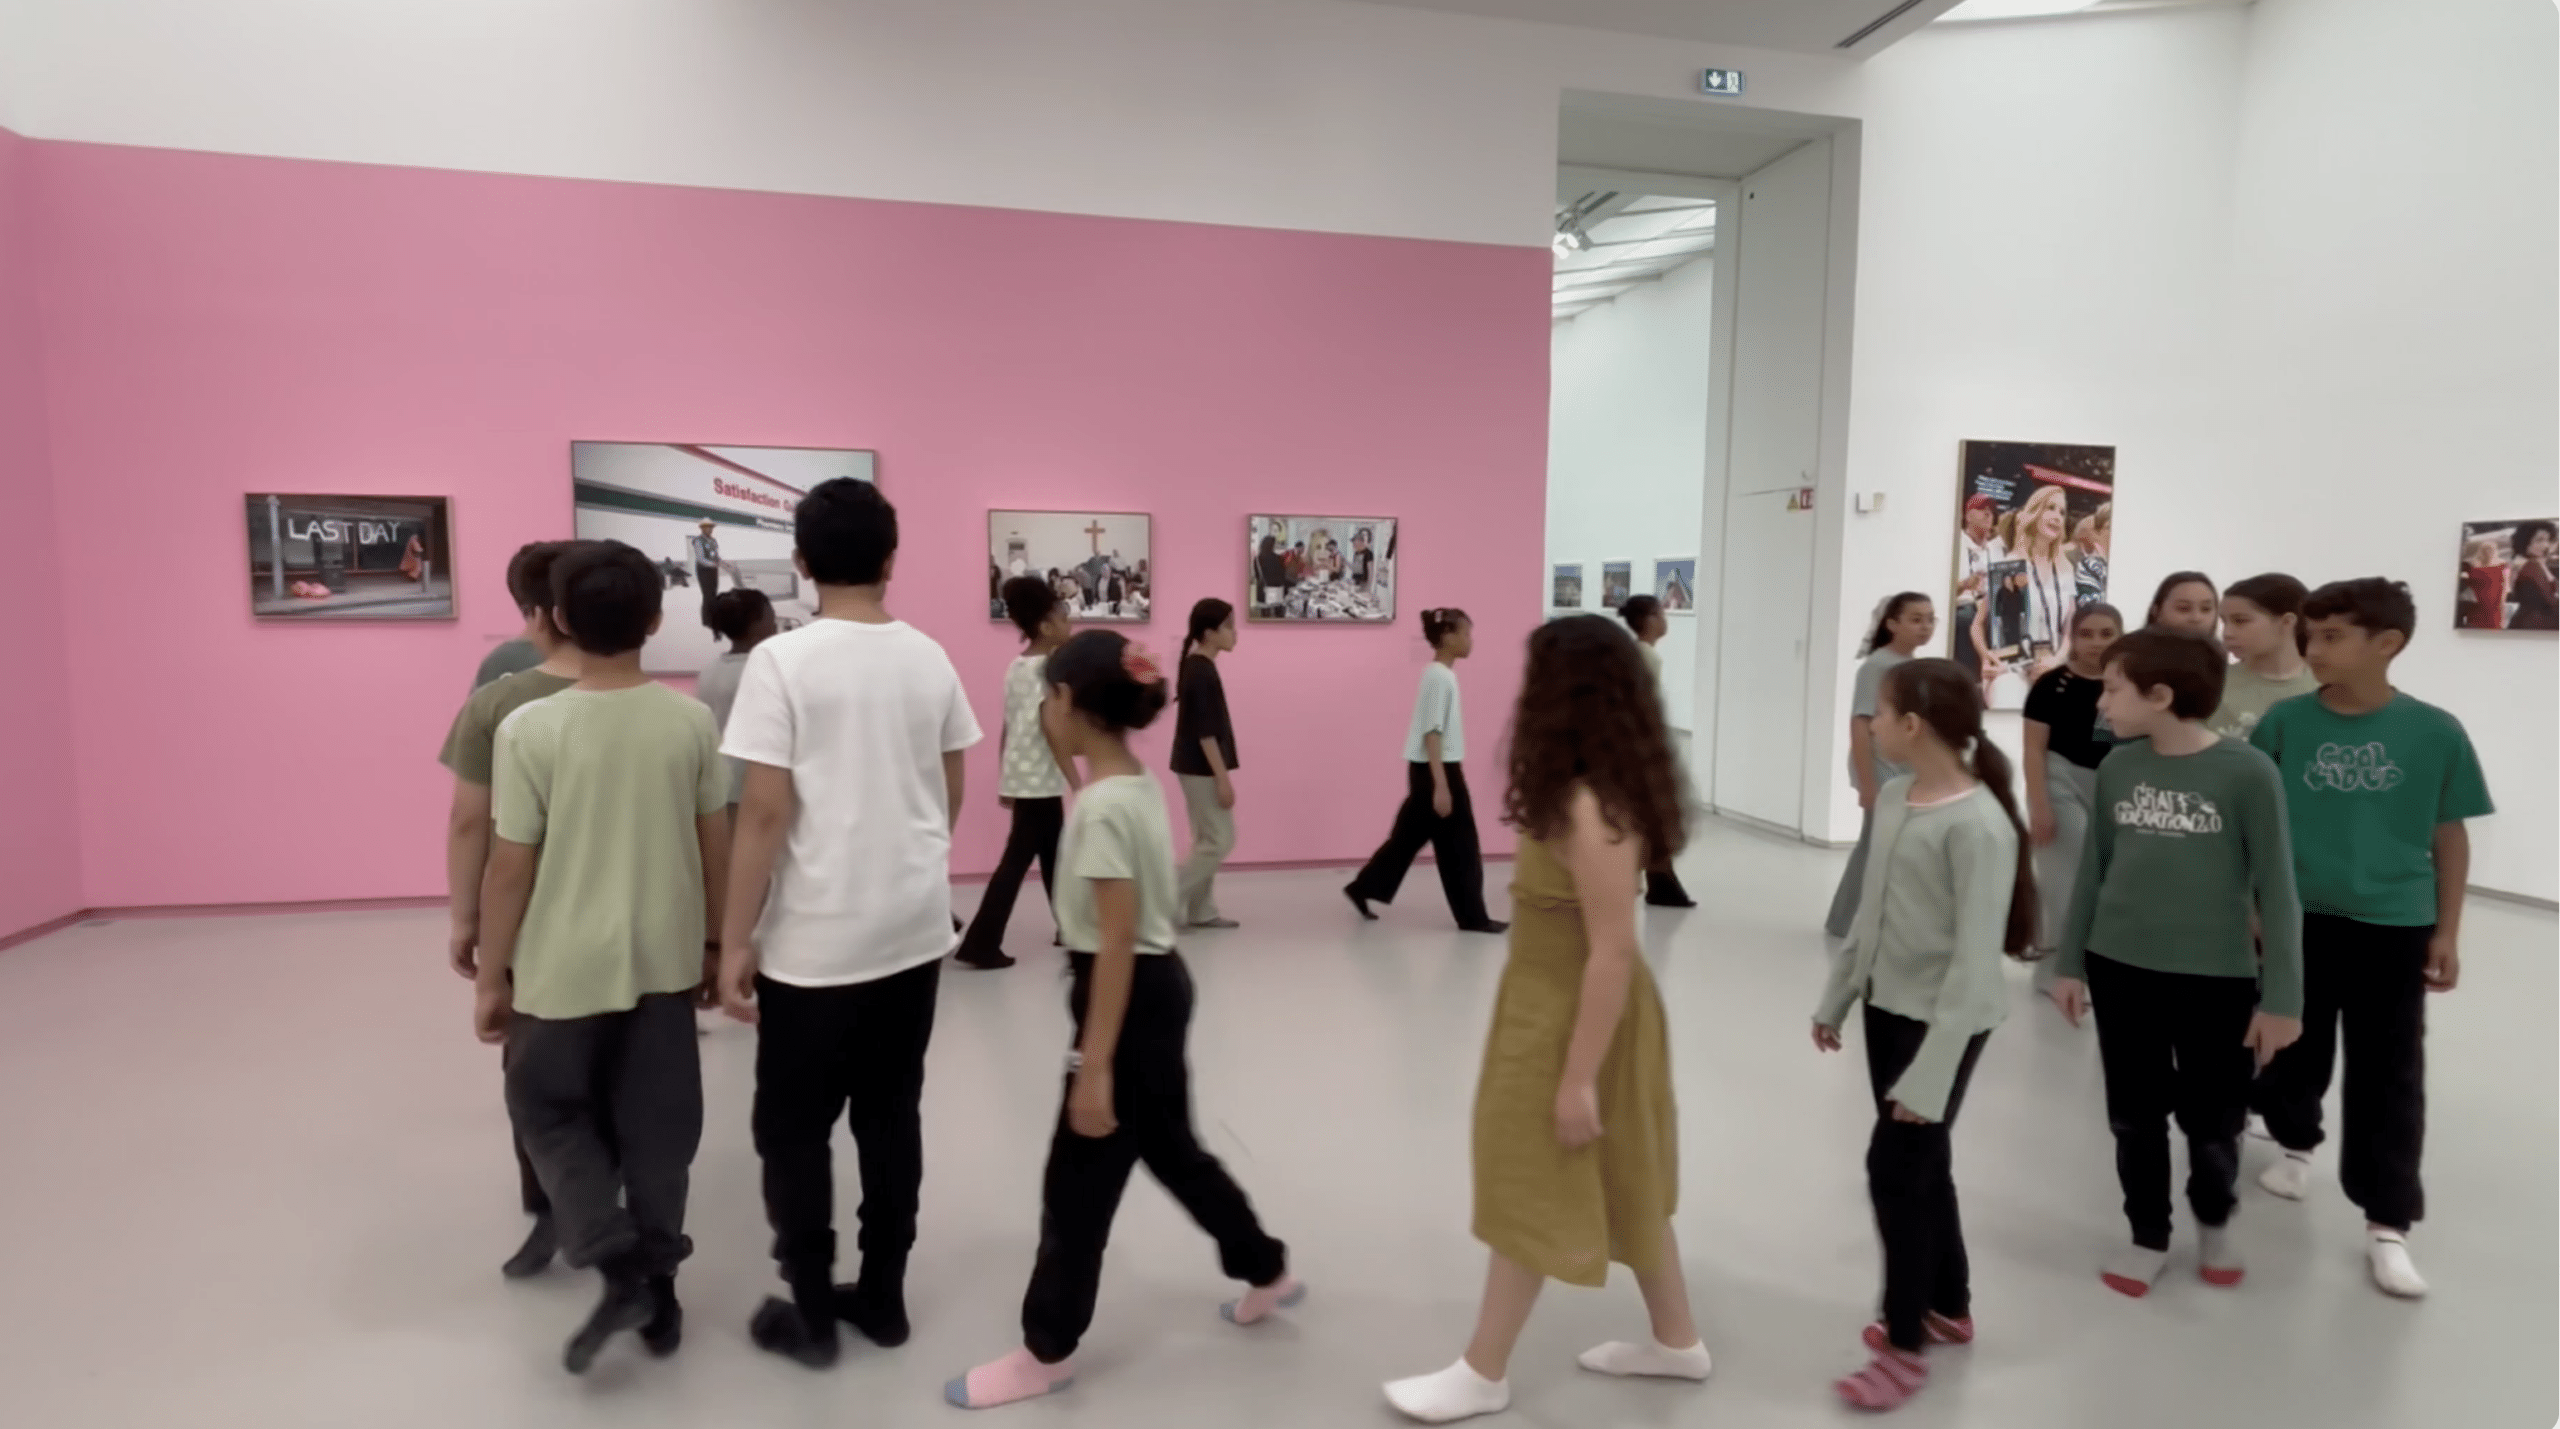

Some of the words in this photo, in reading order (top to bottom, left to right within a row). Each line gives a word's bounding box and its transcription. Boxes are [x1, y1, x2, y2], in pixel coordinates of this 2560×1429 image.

[713, 477, 780, 508] Satisfaction
[287, 518, 353, 544] LAST
[358, 521, 401, 545] DAY
